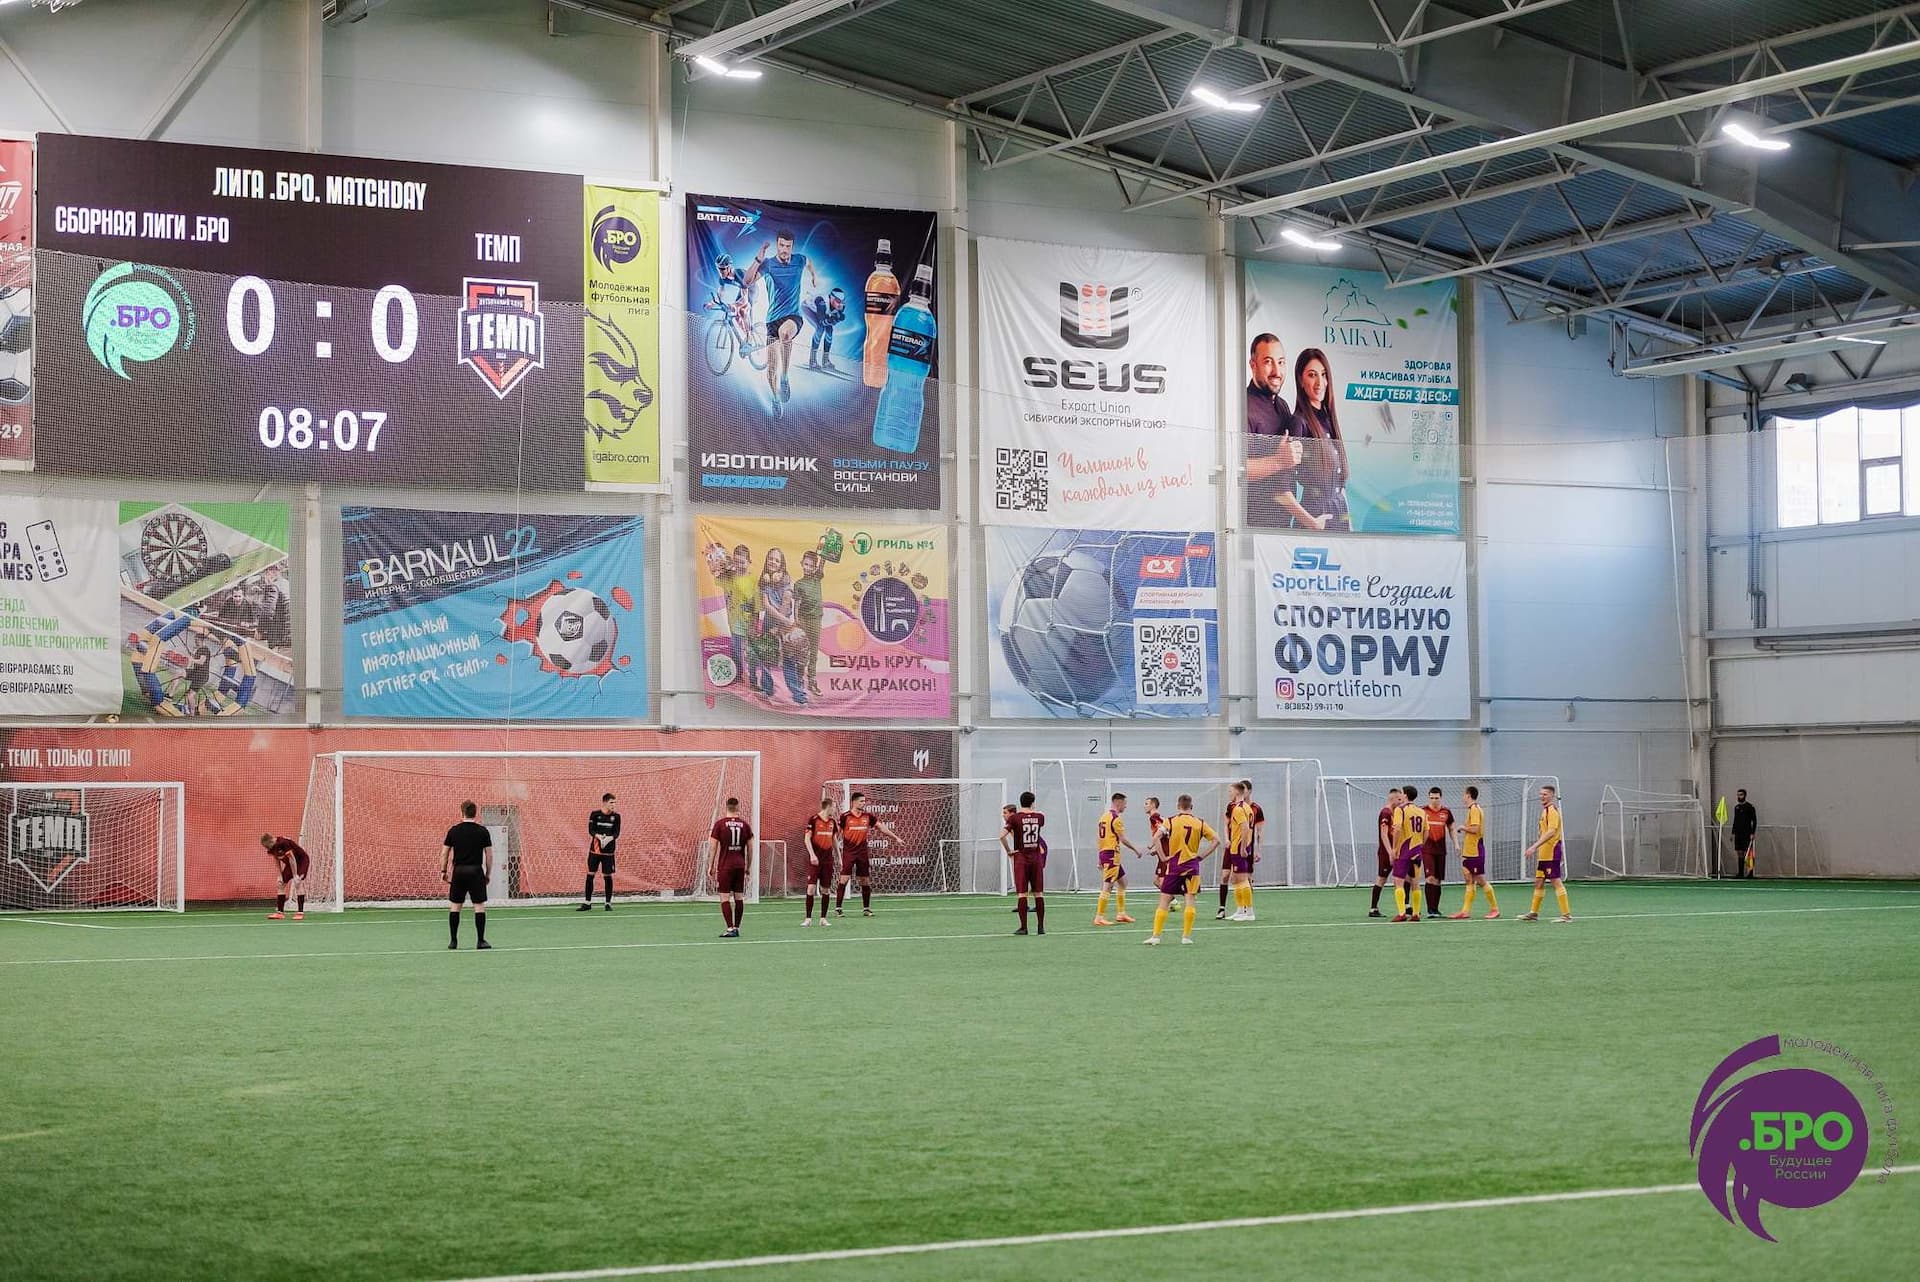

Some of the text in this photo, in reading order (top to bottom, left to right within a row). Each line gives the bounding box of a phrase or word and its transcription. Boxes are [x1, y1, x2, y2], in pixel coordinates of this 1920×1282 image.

[212, 167, 428, 211] ЛИГА .БРО. MATCHDAY
[55, 205, 230, 243] СБОРНАЯ ЛИГИ .БРО
[475, 232, 521, 263] ТЕМП
[603, 229, 637, 246] .БРО
[591, 290, 650, 305] футбольная
[110, 305, 171, 329] .БРО
[226, 275, 275, 356] 0
[371, 284, 419, 363] 0
[467, 313, 535, 355] ТЕМП
[1324, 326, 1392, 348] BAIKAL
[1023, 356, 1167, 394] SEUS
[1404, 360, 1451, 371] ЗДОРОВАЯ
[1361, 371, 1452, 384] И КРАСИВАЯ УЛЫБКА
[1354, 386, 1452, 403] ЖДЕТ ТЕБЯ ЗДЕСЬ!
[1061, 399, 1131, 414] Export Union
[258, 406, 387, 452] 08:07
[1023, 412, 1078, 426] СИБИРСКИЙ
[1080, 415, 1141, 428] ЭКСПОРТНЫЙ
[701, 452, 818, 472] ИЗОТОНИК
[832, 458, 886, 470] ВОЗЬМИ
[1057, 447, 1149, 478] Чемпион в
[833, 471, 918, 483] ВОССТАНОВИ
[1062, 464, 1193, 503] каждом из нас!
[834, 482, 874, 493] СИЛЫ.
[876, 539, 914, 550] ГРИЛЬ
[1291, 547, 1342, 571] SL
[364, 566, 484, 599] ИНТЕРНЕТ СООБЩЕСТВО
[1272, 573, 1360, 593] SportLife
[1366, 574, 1455, 606] Создаем
[1273, 604, 1451, 631] СПОРТИВНУЮ
[360, 614, 449, 648] ГЕНЕРАЛЬНЫЙ
[2, 633, 109, 650] ВАШЕ МЕРОПРИЯТИЕ
[361, 632, 481, 675] ИНФОРМАЦИОННЫЙ
[829, 654, 927, 671] БУДЬ КРУТ,
[1274, 632, 1451, 677] ФОРМУ
[360, 657, 489, 700] ПАРТНЕР ФК «ТЕМП»
[830, 677, 937, 694] КАК ДРАКОН!
[1296, 679, 1402, 701] sportlifebrn
[1088, 738, 1098, 754] 2
[7, 749, 132, 769] ТЕМП, ТОЛЬКО ТЕМП!
[17, 816, 81, 851] ТЕМП
[1022, 824, 1039, 843] 23
[1409, 815, 1422, 833] 18
[730, 826, 741, 845] 11
[1183, 825, 1192, 845] 7
